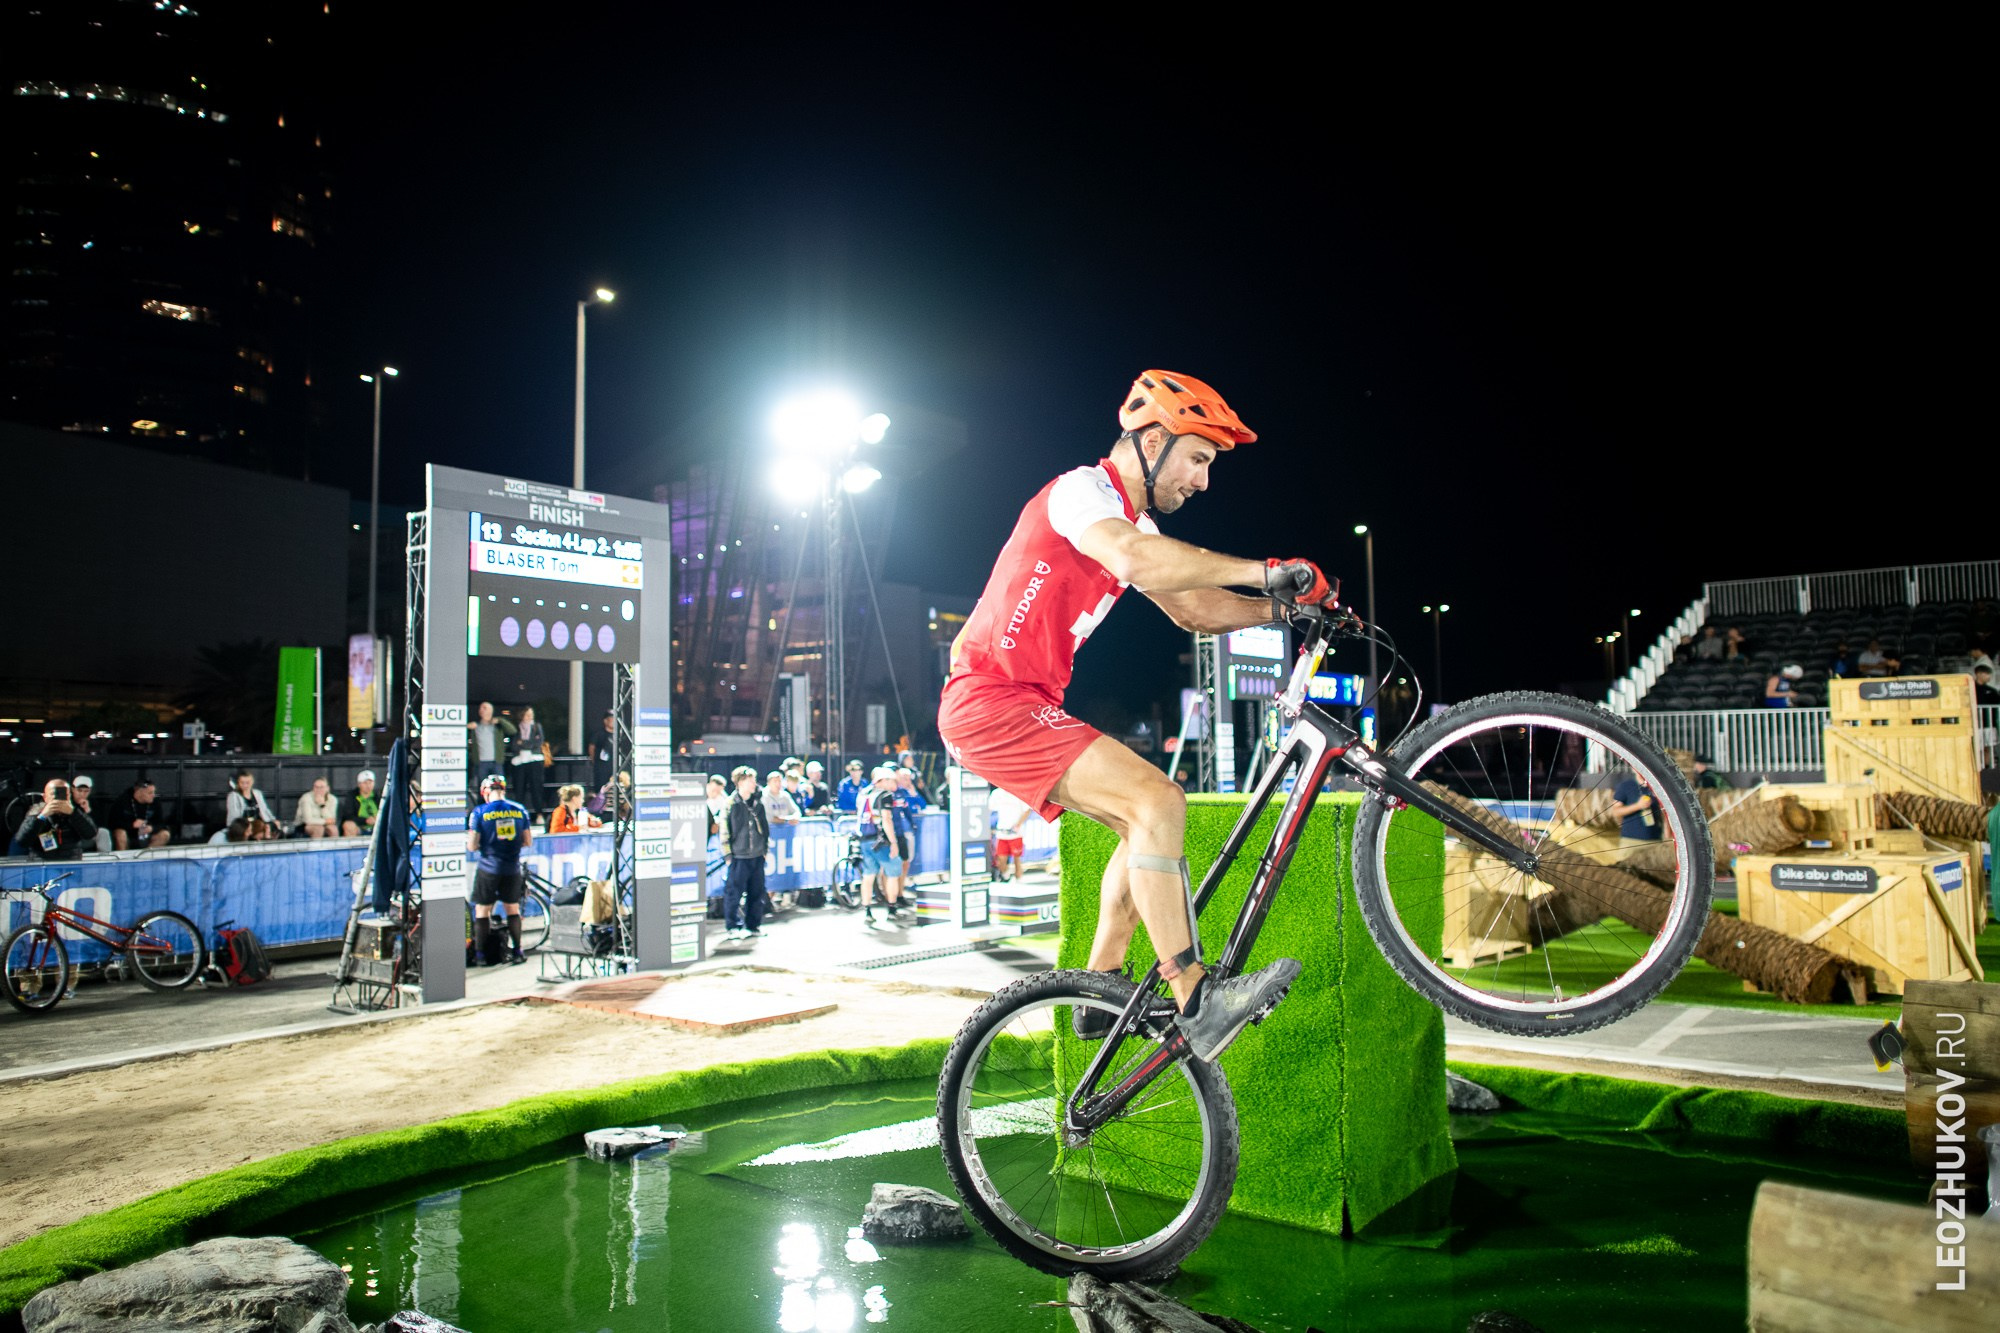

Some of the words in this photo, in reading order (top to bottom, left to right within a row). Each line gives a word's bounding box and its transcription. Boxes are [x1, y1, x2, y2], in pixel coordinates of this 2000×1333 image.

[1159, 412, 1179, 431] SMITH
[508, 482, 526, 492] UCI
[529, 503, 584, 528] FINISH
[481, 521, 502, 542] 13
[487, 549, 545, 569] BLASER
[551, 557, 579, 574] Tom
[1007, 577, 1044, 634] TUDOR
[1889, 681, 1906, 690] Abu
[1907, 681, 1932, 690] Dhabi
[1889, 690, 1909, 698] Sports
[1910, 688, 1932, 697] Council
[434, 709, 462, 721] UCI
[281, 724, 291, 752] ABU
[438, 797, 454, 805] UCI
[483, 810, 523, 822] ROMANIA
[670, 804, 705, 820] INISH
[968, 806, 983, 839] 5
[673, 821, 696, 858] 4
[647, 844, 667, 855] UCI
[434, 859, 462, 872] UCI
[1779, 868, 1804, 880] bike
[1805, 869, 1829, 881] abu
[1831, 869, 1868, 882] dhabi
[1041, 905, 1059, 920] UC
